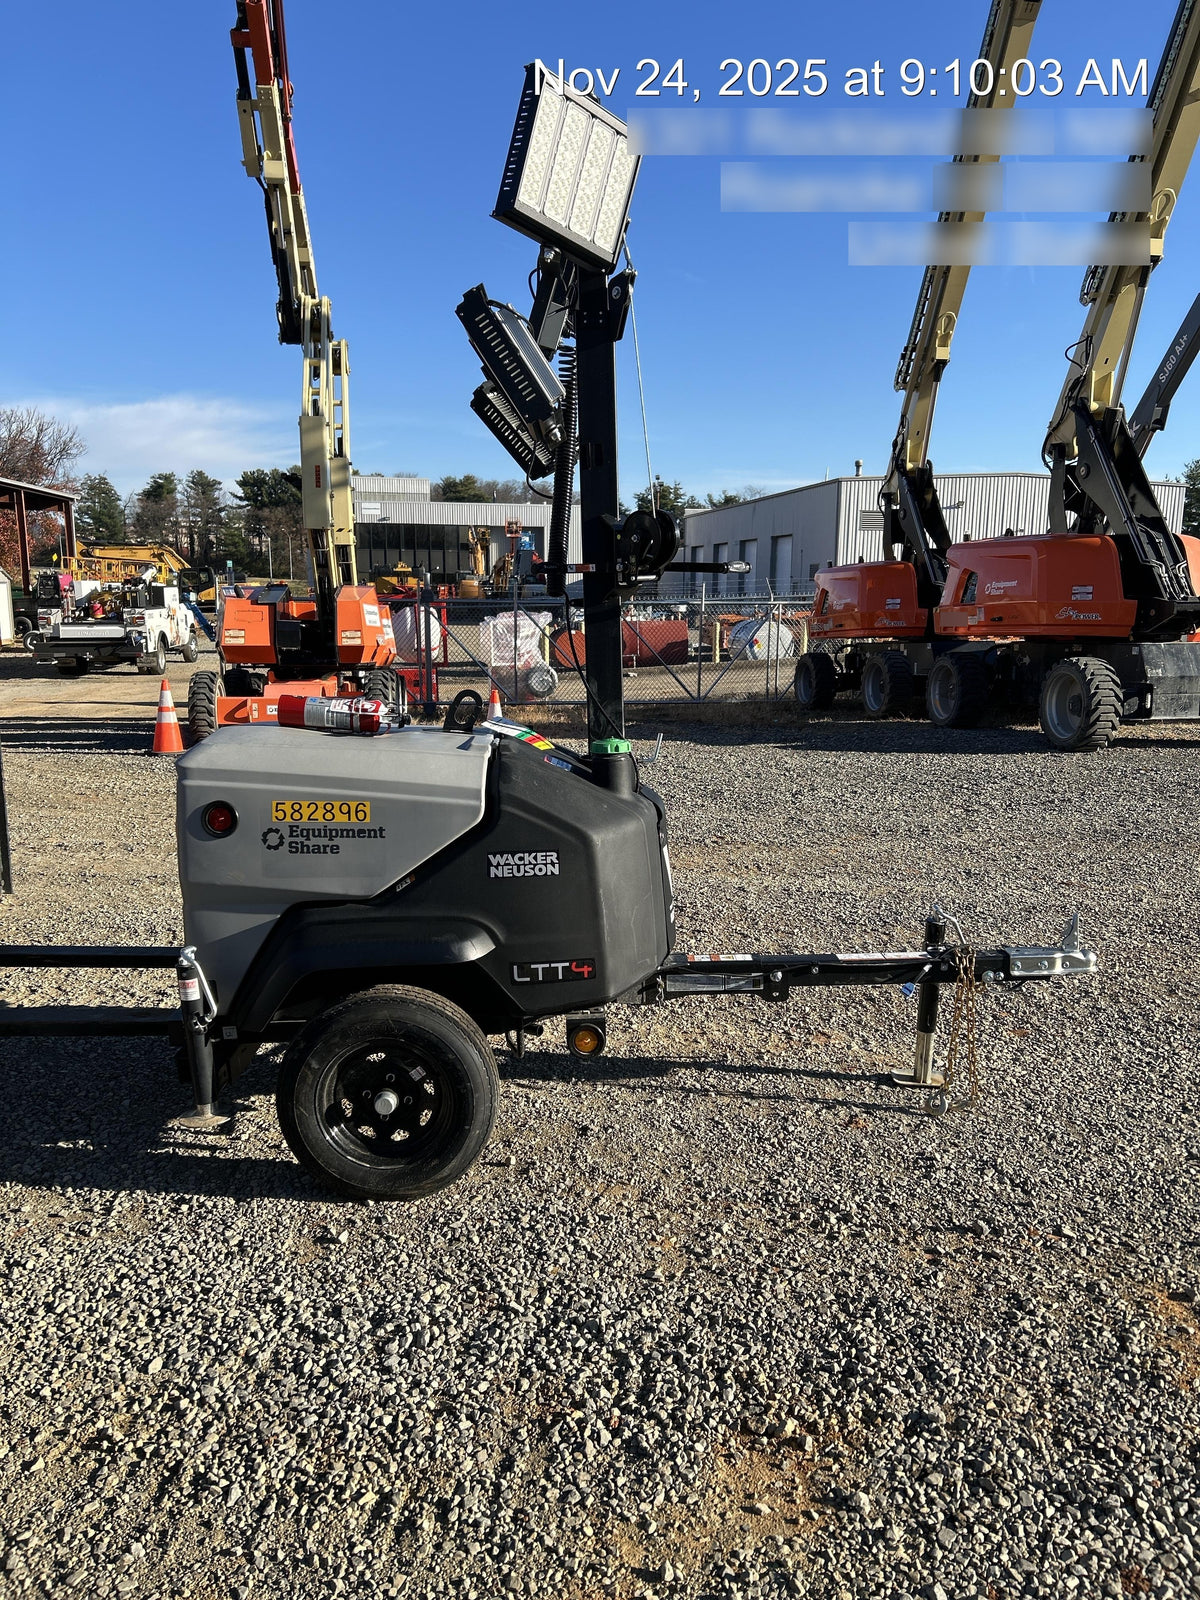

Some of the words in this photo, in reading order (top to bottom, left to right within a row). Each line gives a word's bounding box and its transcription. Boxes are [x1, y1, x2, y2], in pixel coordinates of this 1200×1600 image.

[1158, 354, 1177, 383] SJ60
[1174, 334, 1188, 356] AJ+
[274, 801, 368, 822] 582896
[288, 824, 387, 841] Equipment
[288, 840, 341, 855] Share
[487, 851, 560, 866] WACKER
[489, 863, 560, 878] NEUSON
